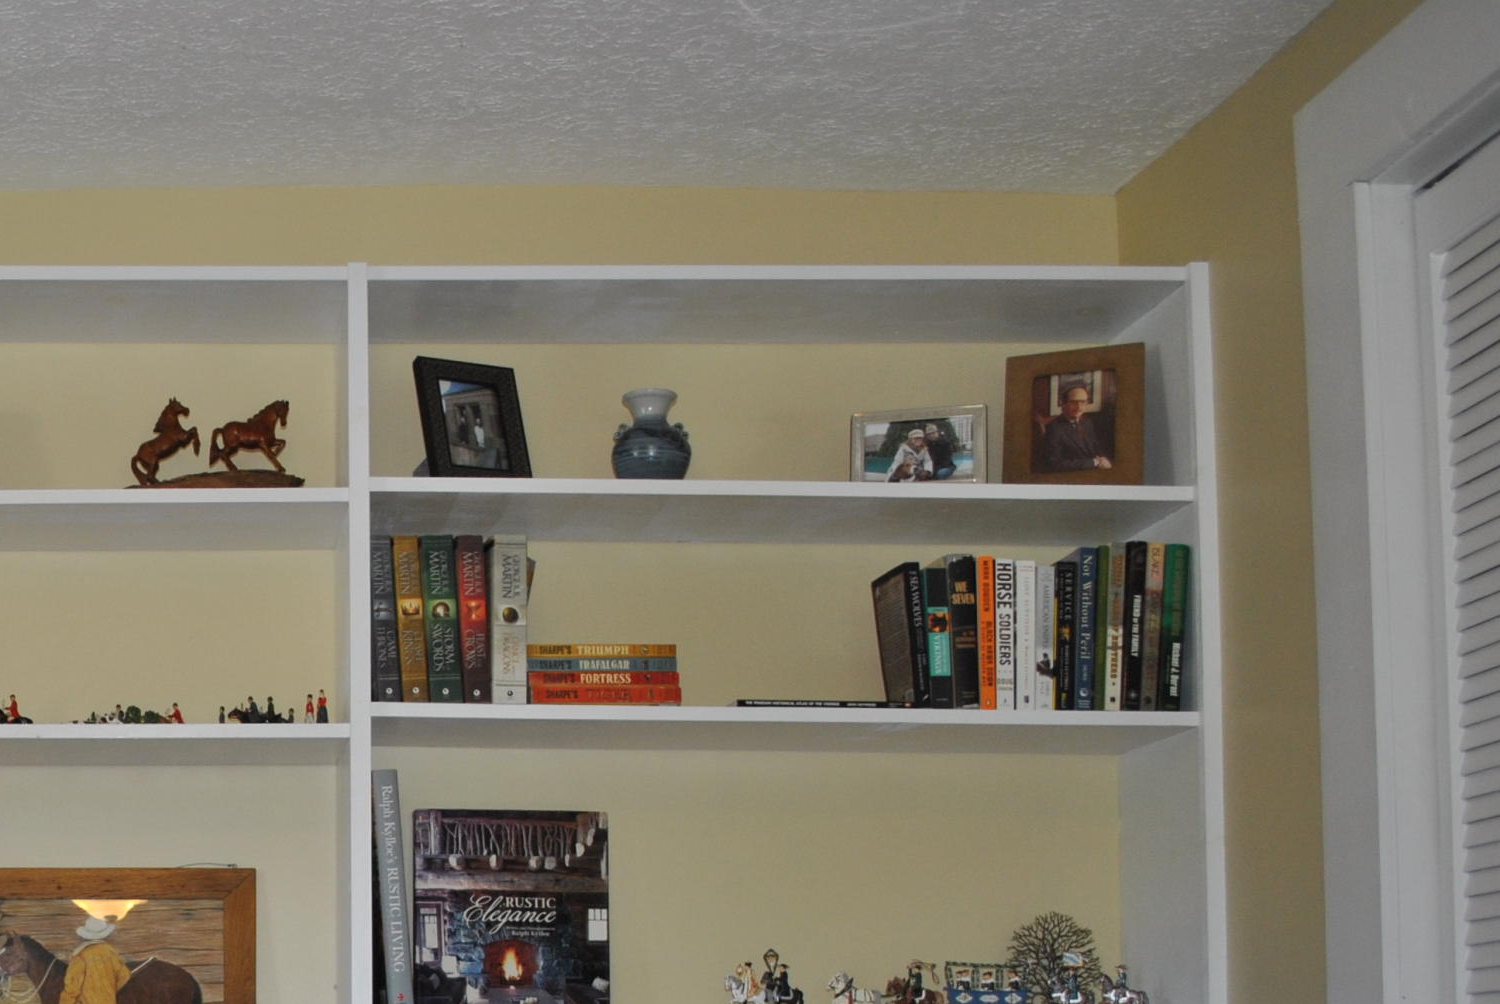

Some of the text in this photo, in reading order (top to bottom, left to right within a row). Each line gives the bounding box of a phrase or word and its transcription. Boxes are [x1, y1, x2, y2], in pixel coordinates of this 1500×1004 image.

[428, 551, 441, 596] MARTIN
[462, 551, 475, 596] MARTIN
[501, 554, 513, 599] MARTIN
[512, 554, 522, 580] GEORGE
[954, 580, 967, 592] WE
[982, 560, 991, 612] MARK BOWDEN
[911, 592, 923, 627] WOLVES
[951, 592, 976, 605] SEVEN
[996, 562, 1013, 666] HORSE SOLDIERS
[1042, 584, 1051, 621] AMERICAN
[1064, 572, 1074, 622] SERVICE
[1079, 554, 1094, 660] Not Without Peril
[386, 630, 397, 659] GAME
[1130, 594, 1142, 658] FRIEND THE FAMILY
[376, 627, 389, 669] THRONES
[403, 630, 414, 665] KINGS
[432, 624, 445, 673] SWORDS
[443, 627, 455, 664] STORM
[465, 629, 476, 670] CROWS
[476, 633, 486, 659] FEAST
[577, 645, 629, 656] TRIUMPH
[579, 659, 630, 670] TRAFALGAR
[933, 635, 943, 674] VIKINGS
[986, 621, 995, 687] BLACK HAWK DOWN
[1171, 642, 1181, 668] Michael
[580, 673, 632, 685] FORTRESS
[1169, 675, 1180, 697] Durant
[379, 785, 405, 973] Ralph Kylloe's RUSTIC LIVING
[463, 895, 557, 934] Elegance
[504, 896, 557, 909] RUSTIC
